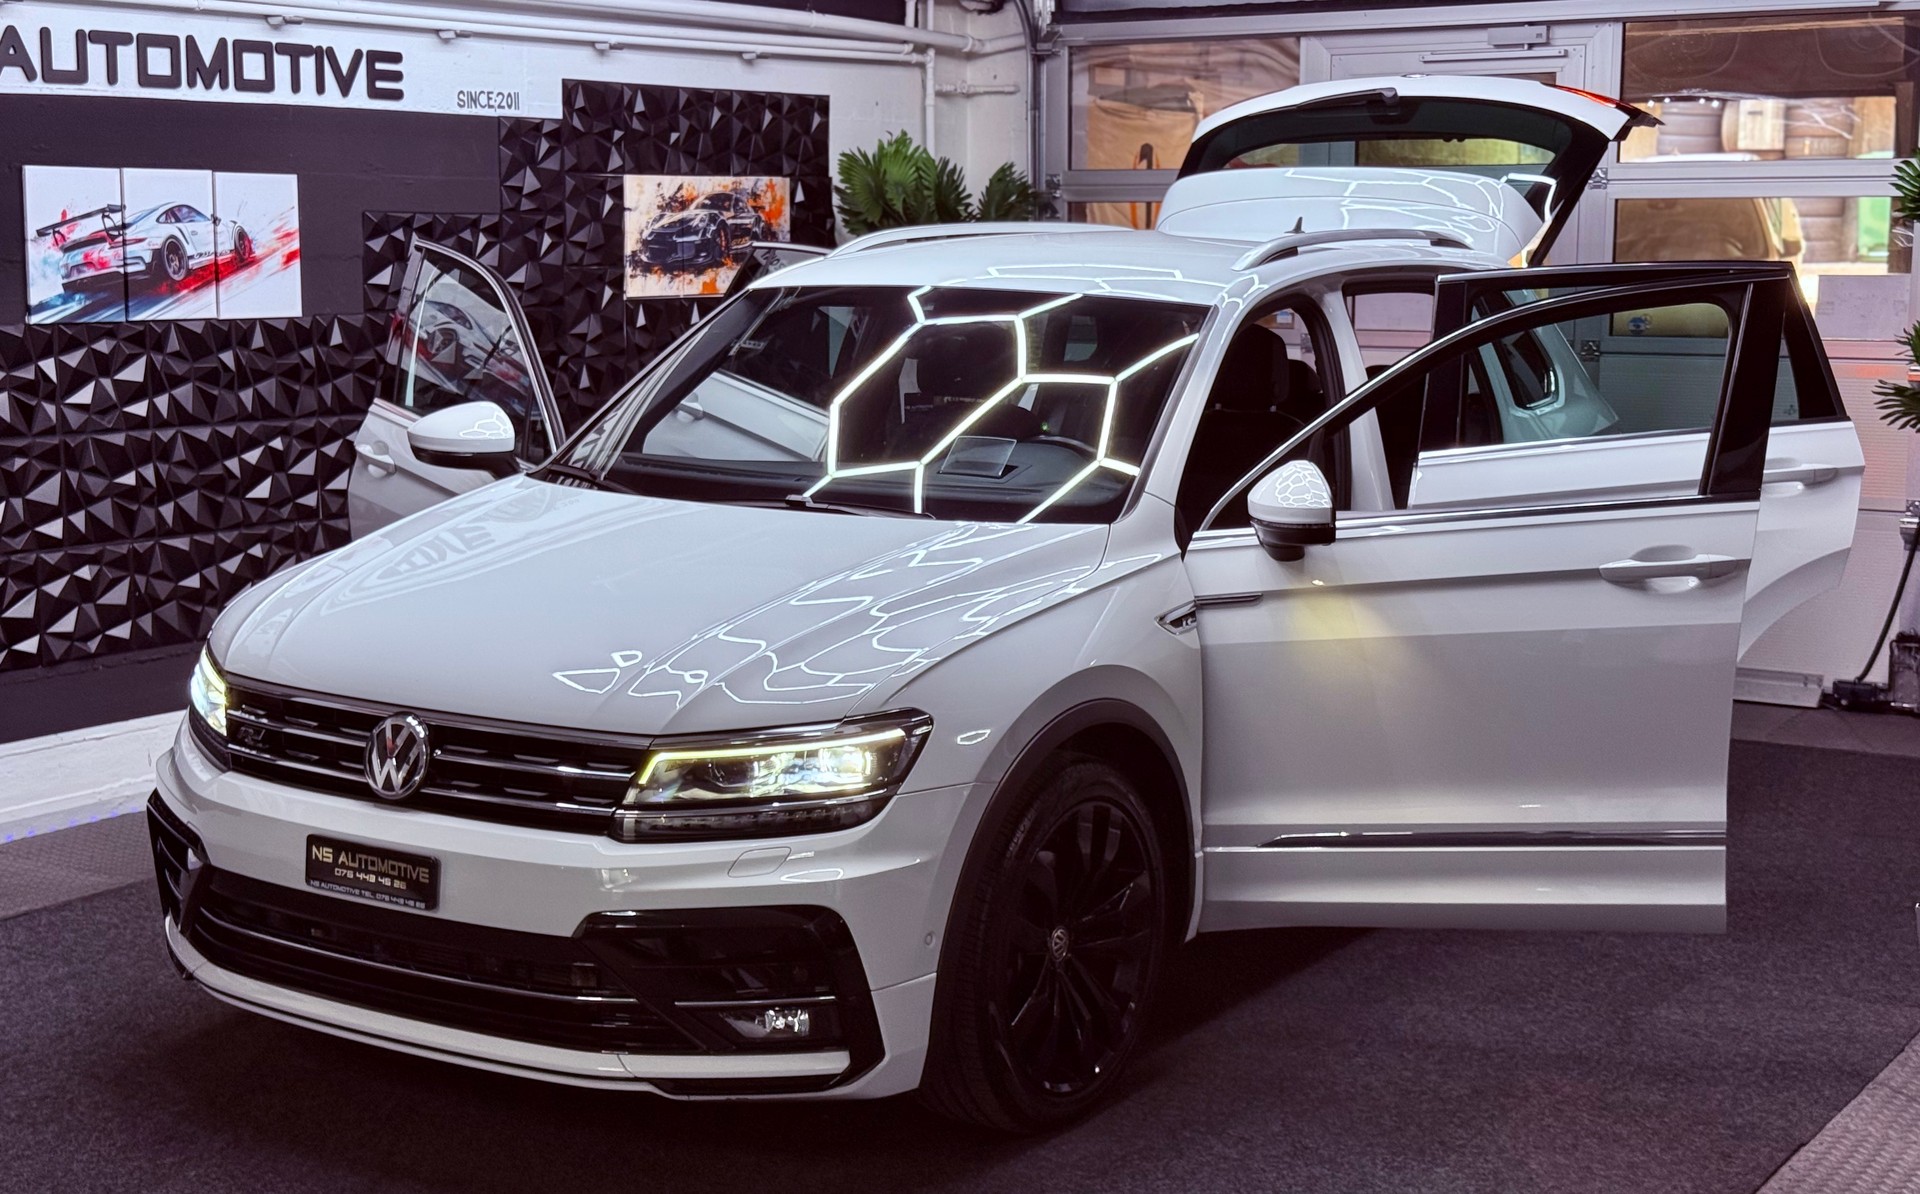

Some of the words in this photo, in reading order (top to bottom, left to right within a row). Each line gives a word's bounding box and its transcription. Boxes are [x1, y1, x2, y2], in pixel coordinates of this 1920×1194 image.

[0, 25, 404, 101] AUTOMOTIVE
[366, 712, 429, 799] VW
[312, 844, 333, 863] NS
[338, 850, 430, 884] AUTOMOTIVE
